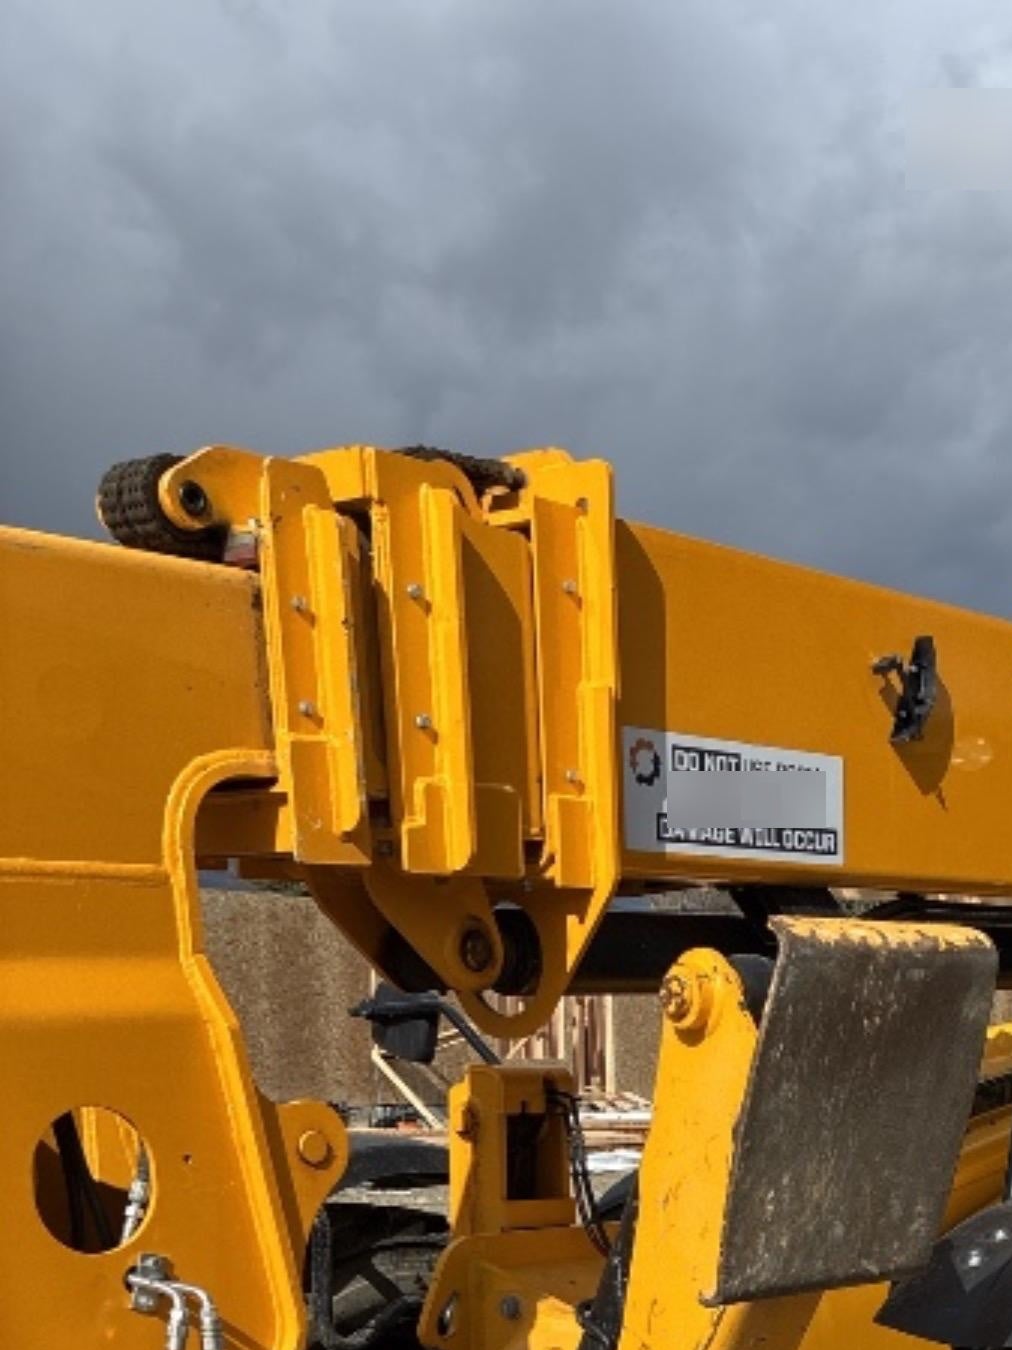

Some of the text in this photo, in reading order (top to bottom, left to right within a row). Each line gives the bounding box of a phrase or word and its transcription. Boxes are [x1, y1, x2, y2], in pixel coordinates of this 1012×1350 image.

[674, 749, 699, 772] DO
[704, 752, 739, 772] NOT
[739, 826, 780, 848] WILL
[782, 828, 835, 852] OCCUR
